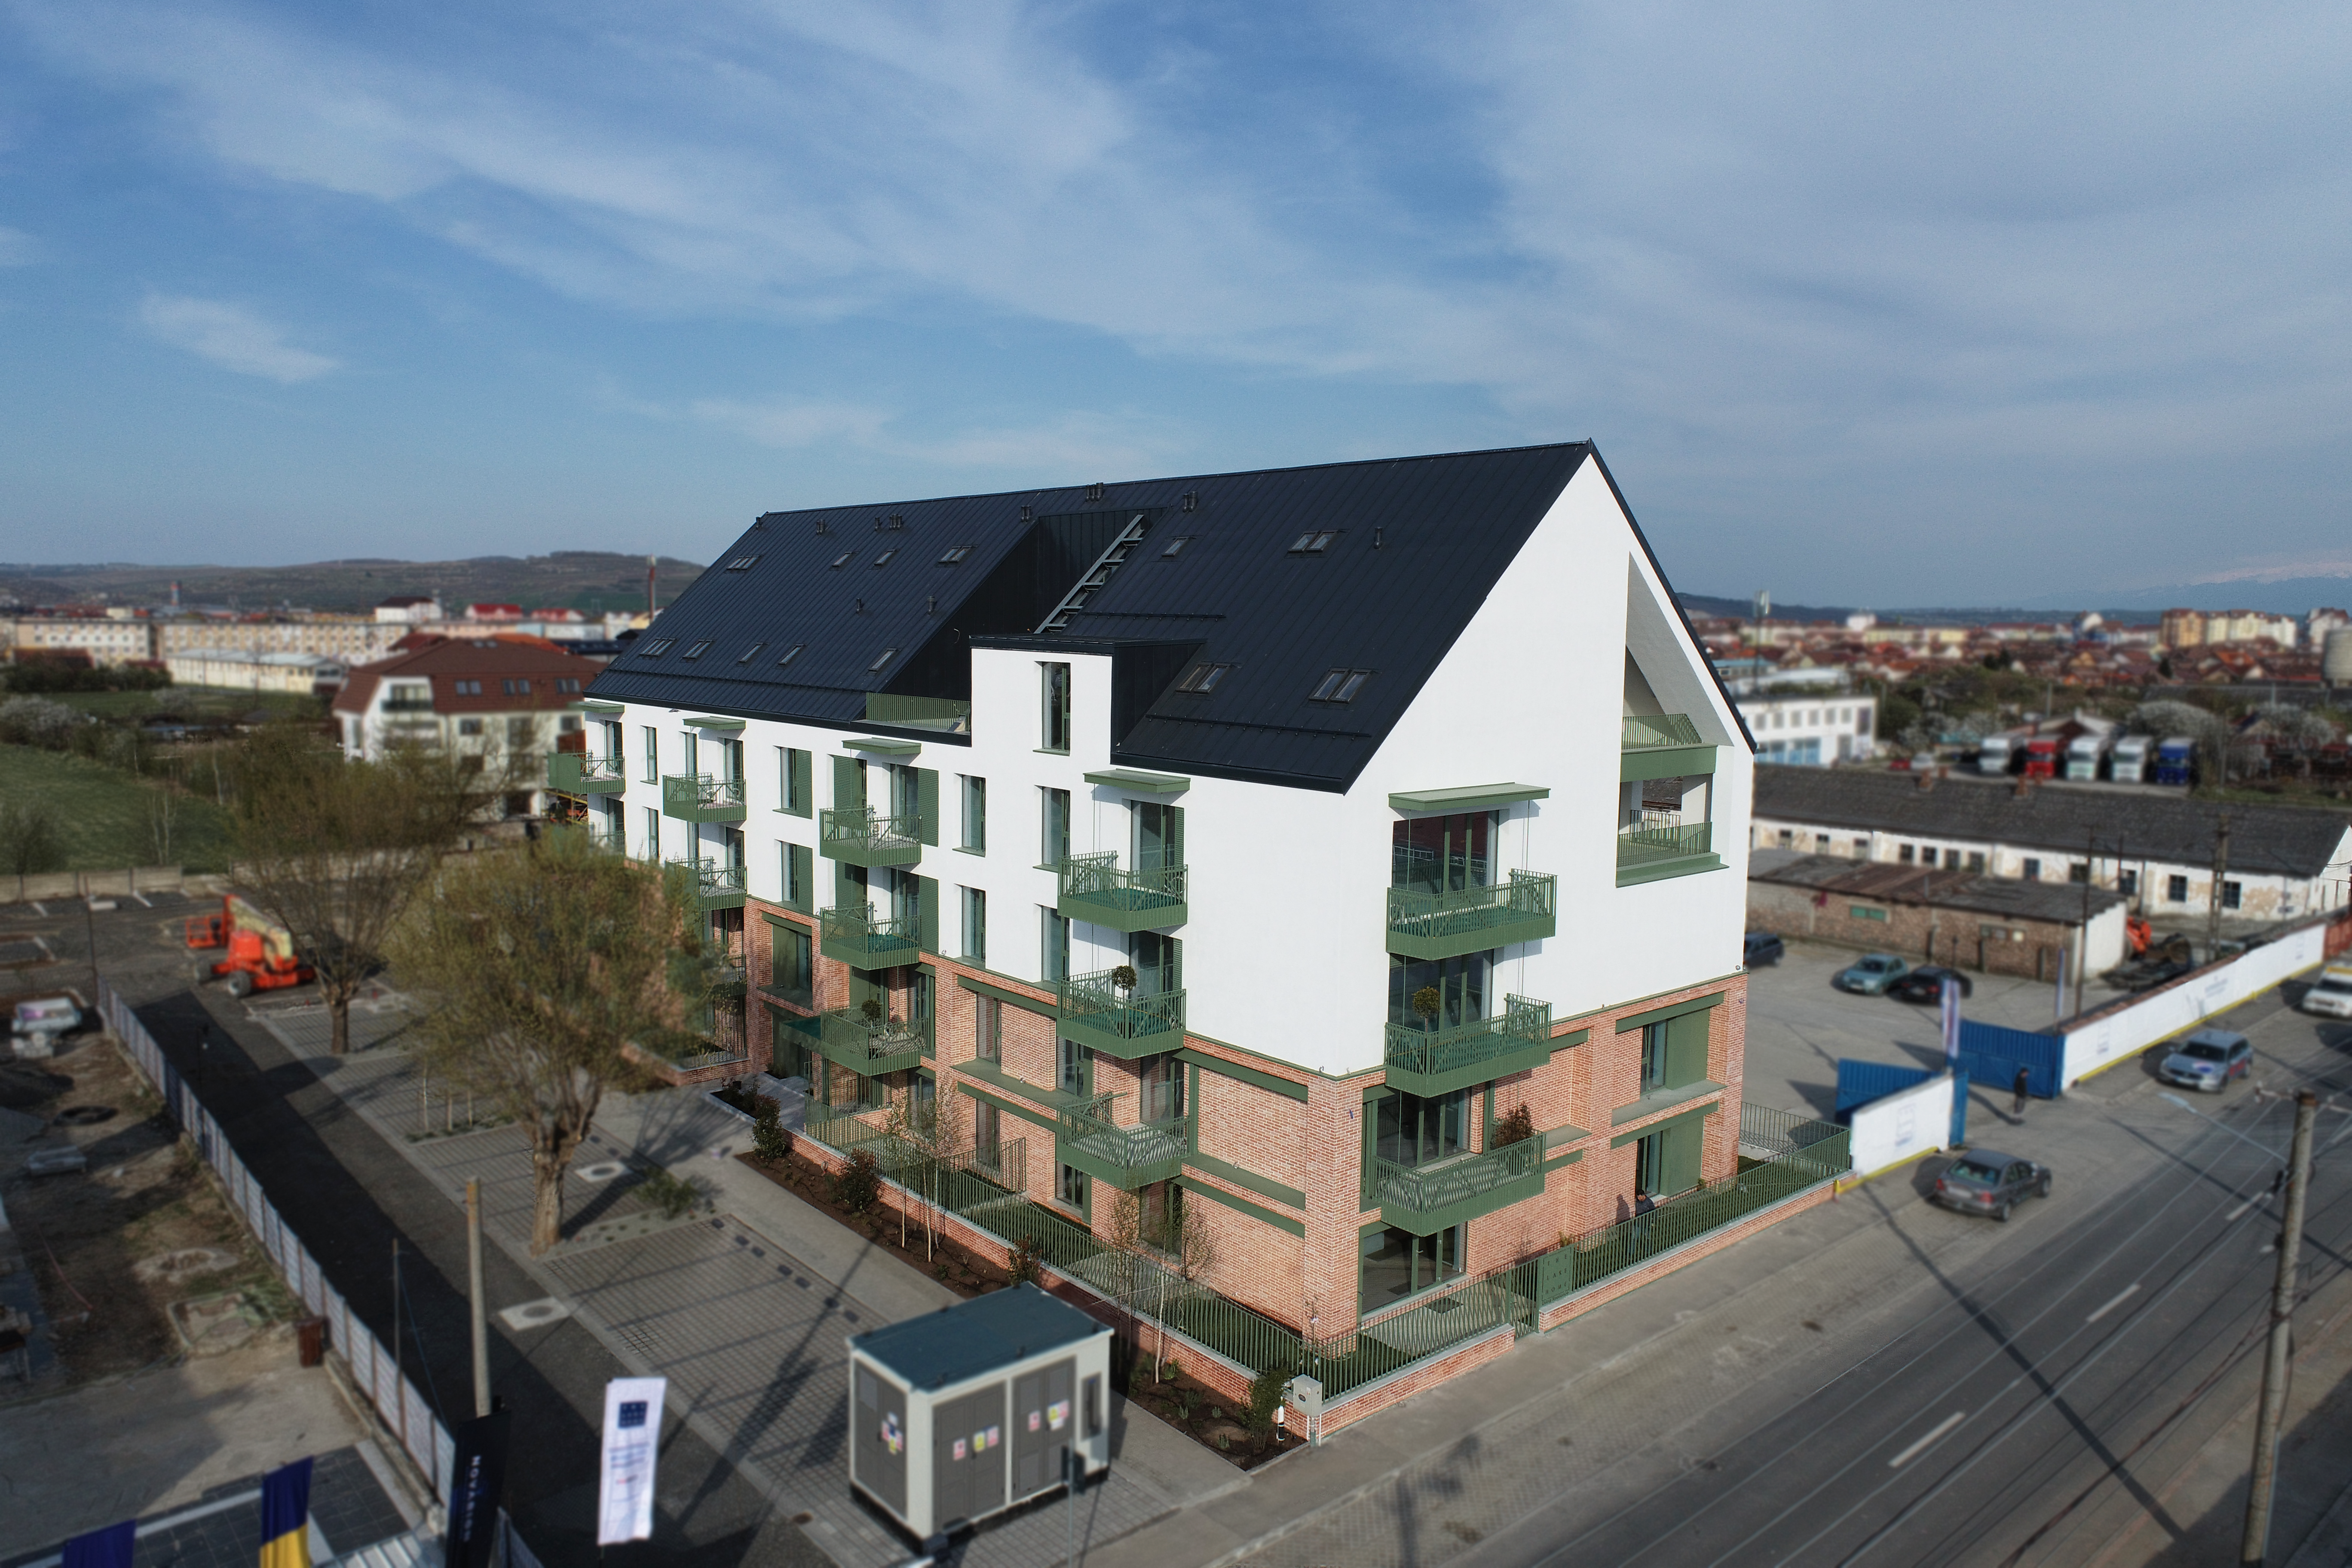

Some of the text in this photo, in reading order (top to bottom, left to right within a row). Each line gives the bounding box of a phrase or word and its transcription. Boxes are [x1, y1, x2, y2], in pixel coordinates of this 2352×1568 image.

[1548, 1254, 1567, 1266] THE
[1547, 1268, 1567, 1280] LAKE
[1545, 1281, 1567, 1295] HOME
